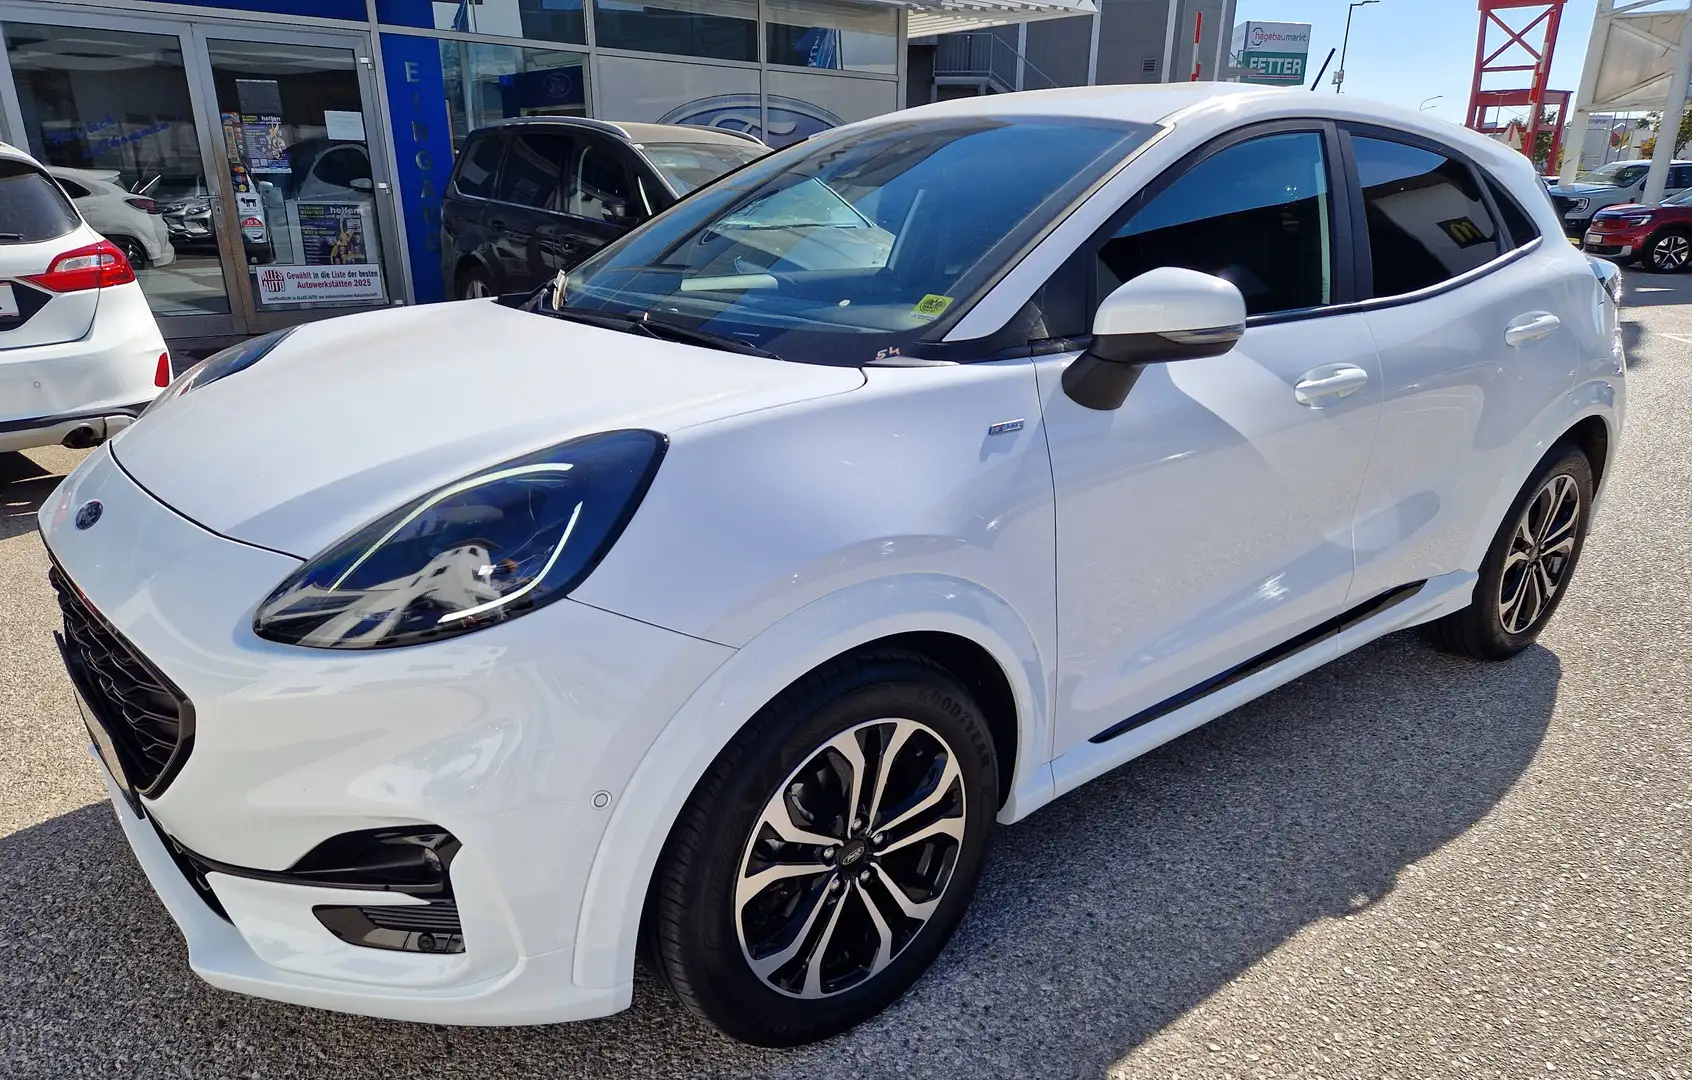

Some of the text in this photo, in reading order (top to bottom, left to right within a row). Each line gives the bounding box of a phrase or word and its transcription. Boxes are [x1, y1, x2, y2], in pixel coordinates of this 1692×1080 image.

[1254, 31, 1307, 42] hagebaumarkt
[1249, 57, 1302, 74] FETTER
[404, 61, 441, 251] EINGANG
[261, 270, 284, 280] ALLES
[286, 269, 379, 280] Gewählt in die Liste der besten
[262, 280, 286, 292] AUTO
[296, 279, 372, 289] Autowerkstätten 2025
[918, 689, 991, 768] GOODYEAR
